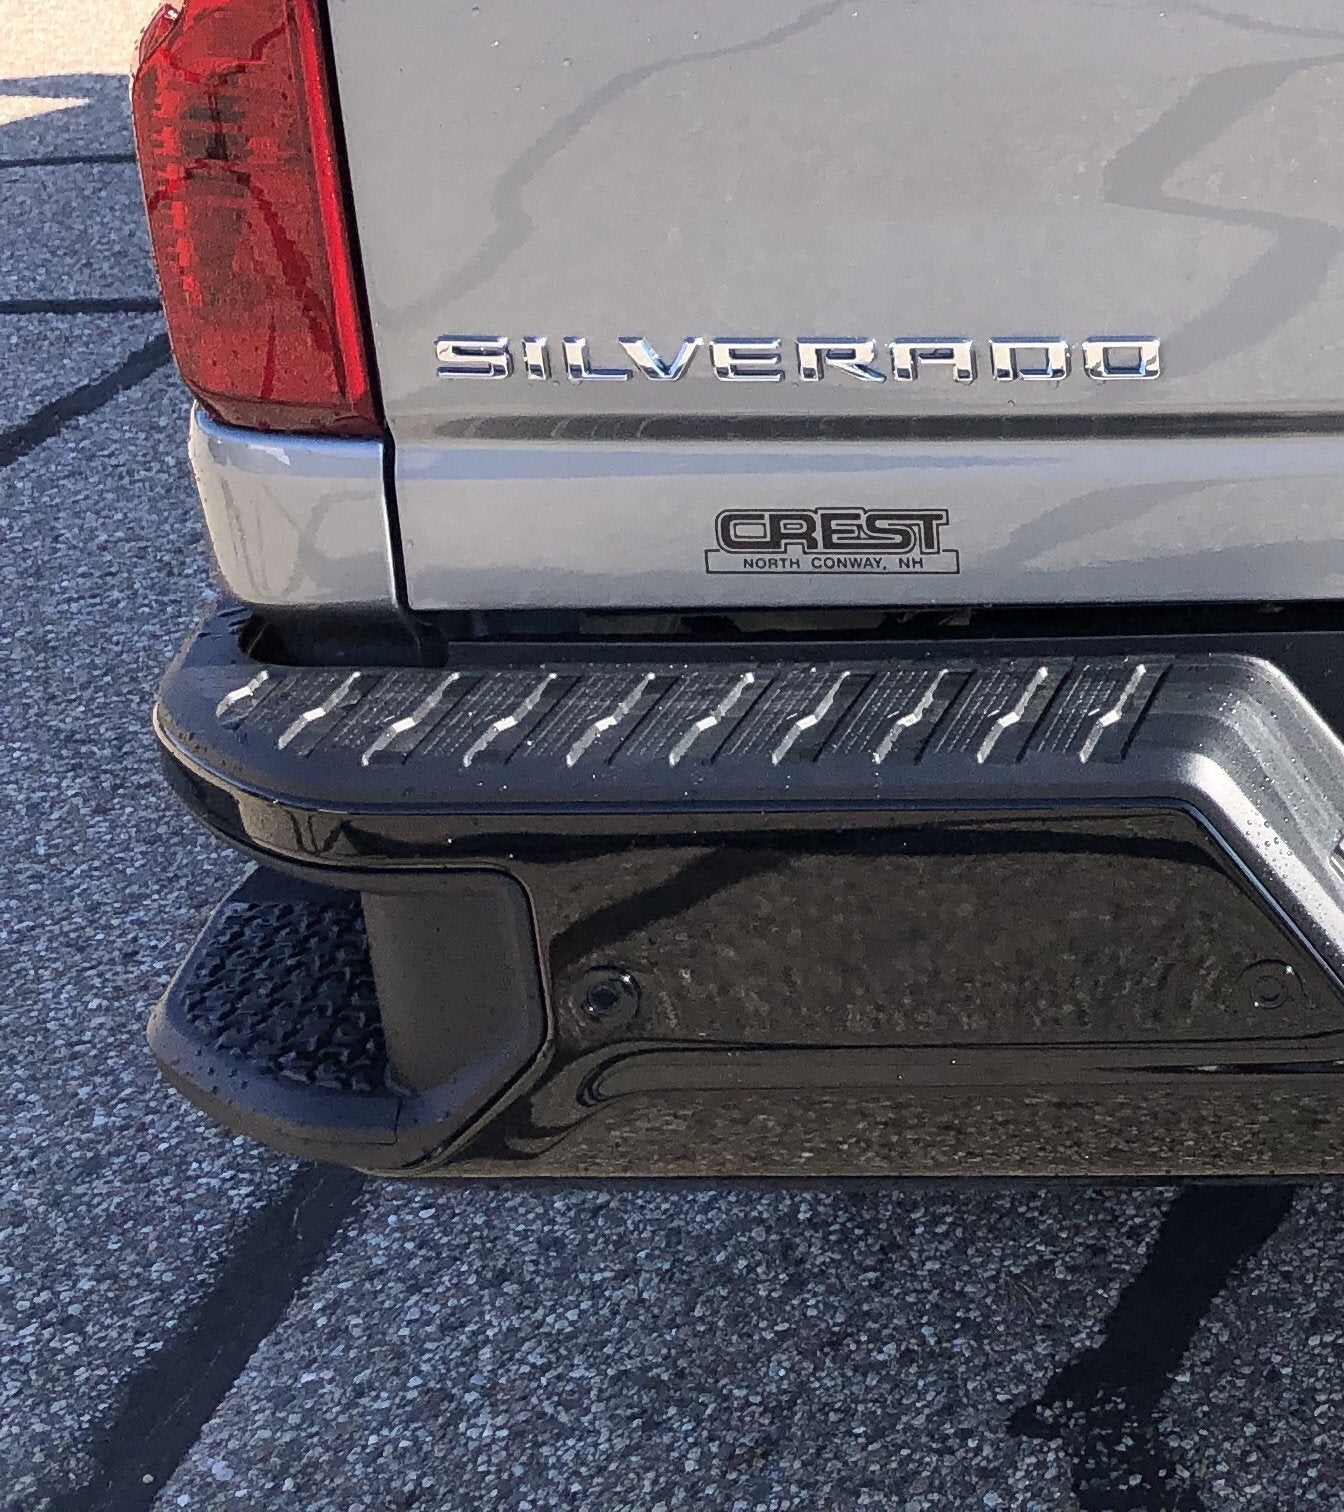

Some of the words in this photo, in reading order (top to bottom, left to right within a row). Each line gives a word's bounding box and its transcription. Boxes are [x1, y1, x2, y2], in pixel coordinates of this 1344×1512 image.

[433, 334, 1163, 384] SILVERADO
[715, 507, 949, 554] CREST
[743, 557, 800, 569] NORTH
[811, 556, 887, 570] CONWAY,
[898, 556, 924, 569] NH
